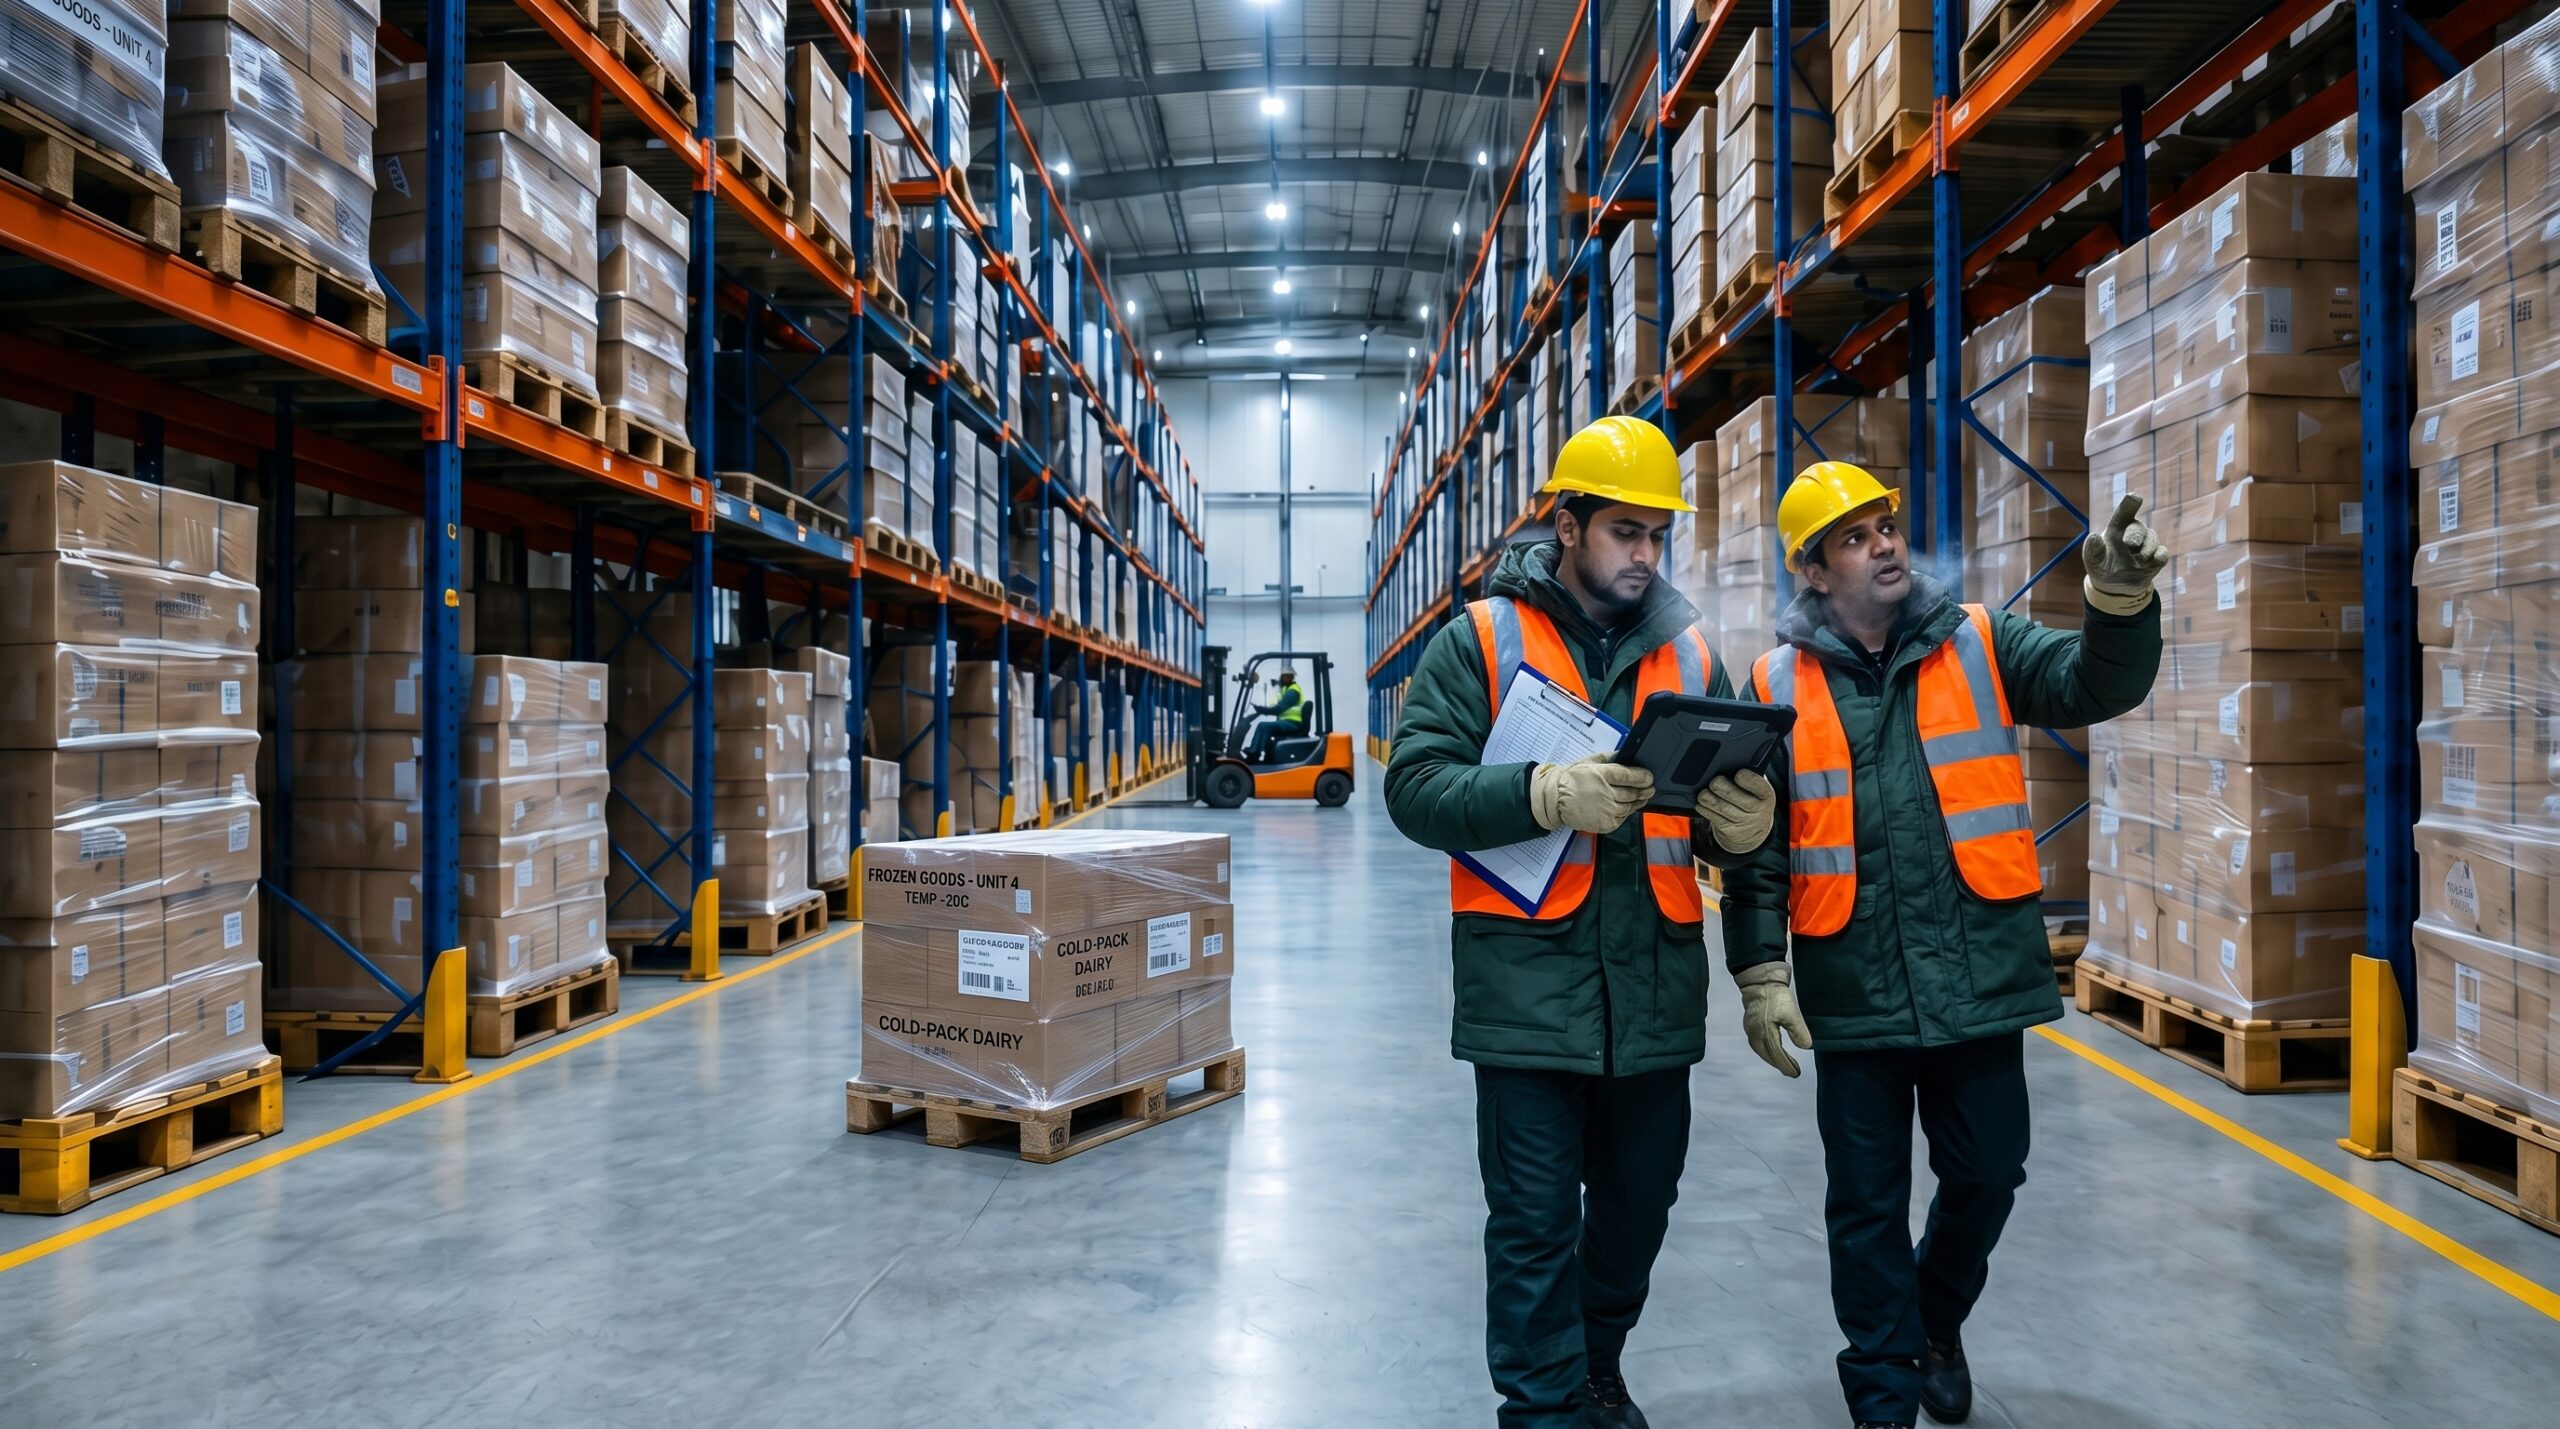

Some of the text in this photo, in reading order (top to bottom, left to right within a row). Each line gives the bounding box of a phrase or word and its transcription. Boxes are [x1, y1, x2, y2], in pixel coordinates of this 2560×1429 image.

[113, 26, 143, 58] UNIT
[145, 49, 153, 70] 4
[868, 868, 917, 884] FROZEN
[920, 871, 966, 887] GOODS
[976, 874, 1008, 889] UNIT
[1011, 876, 1019, 889] 4
[905, 890, 969, 908] TEMP -20C
[1057, 931, 1129, 957] COLD-PACK
[1075, 955, 1113, 976] DAIRY
[879, 1015, 1024, 1050] COLD-PACK DAIRY
